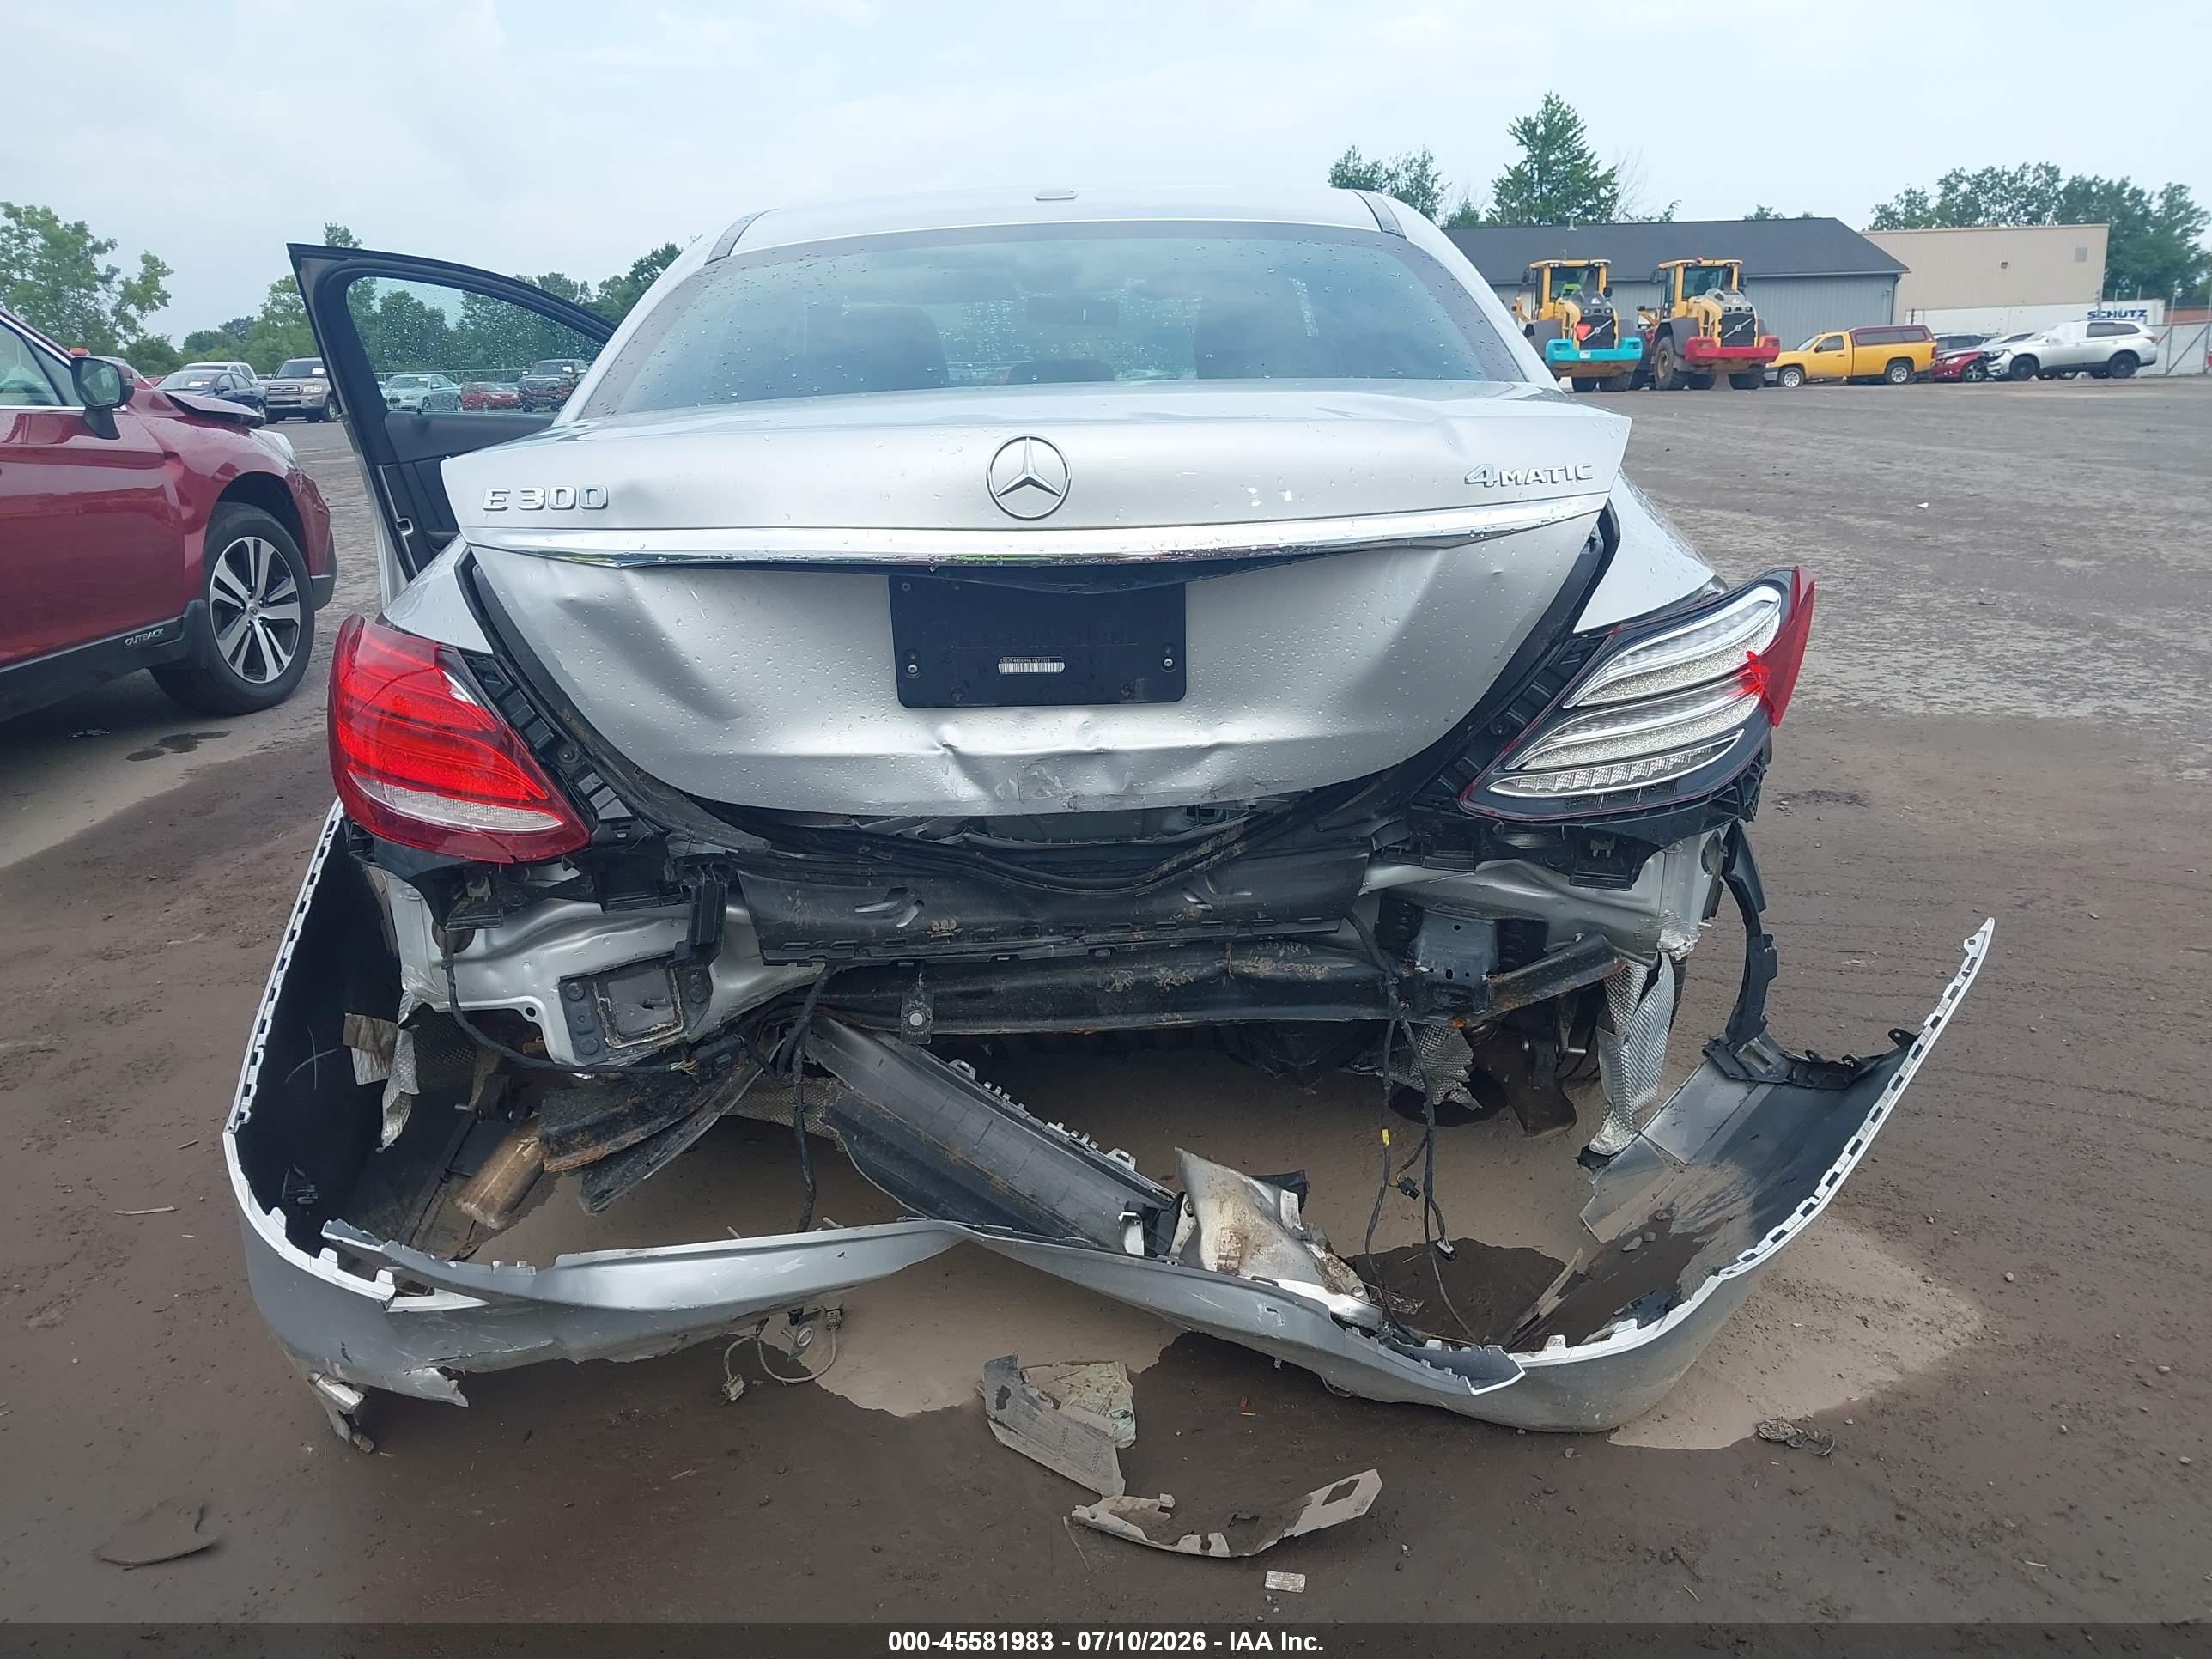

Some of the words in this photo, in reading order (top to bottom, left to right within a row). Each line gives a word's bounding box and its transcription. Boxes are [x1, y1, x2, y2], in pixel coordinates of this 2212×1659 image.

[1464, 463, 1594, 488] 4MATIC
[483, 487, 511, 512] E
[518, 486, 609, 511] 300
